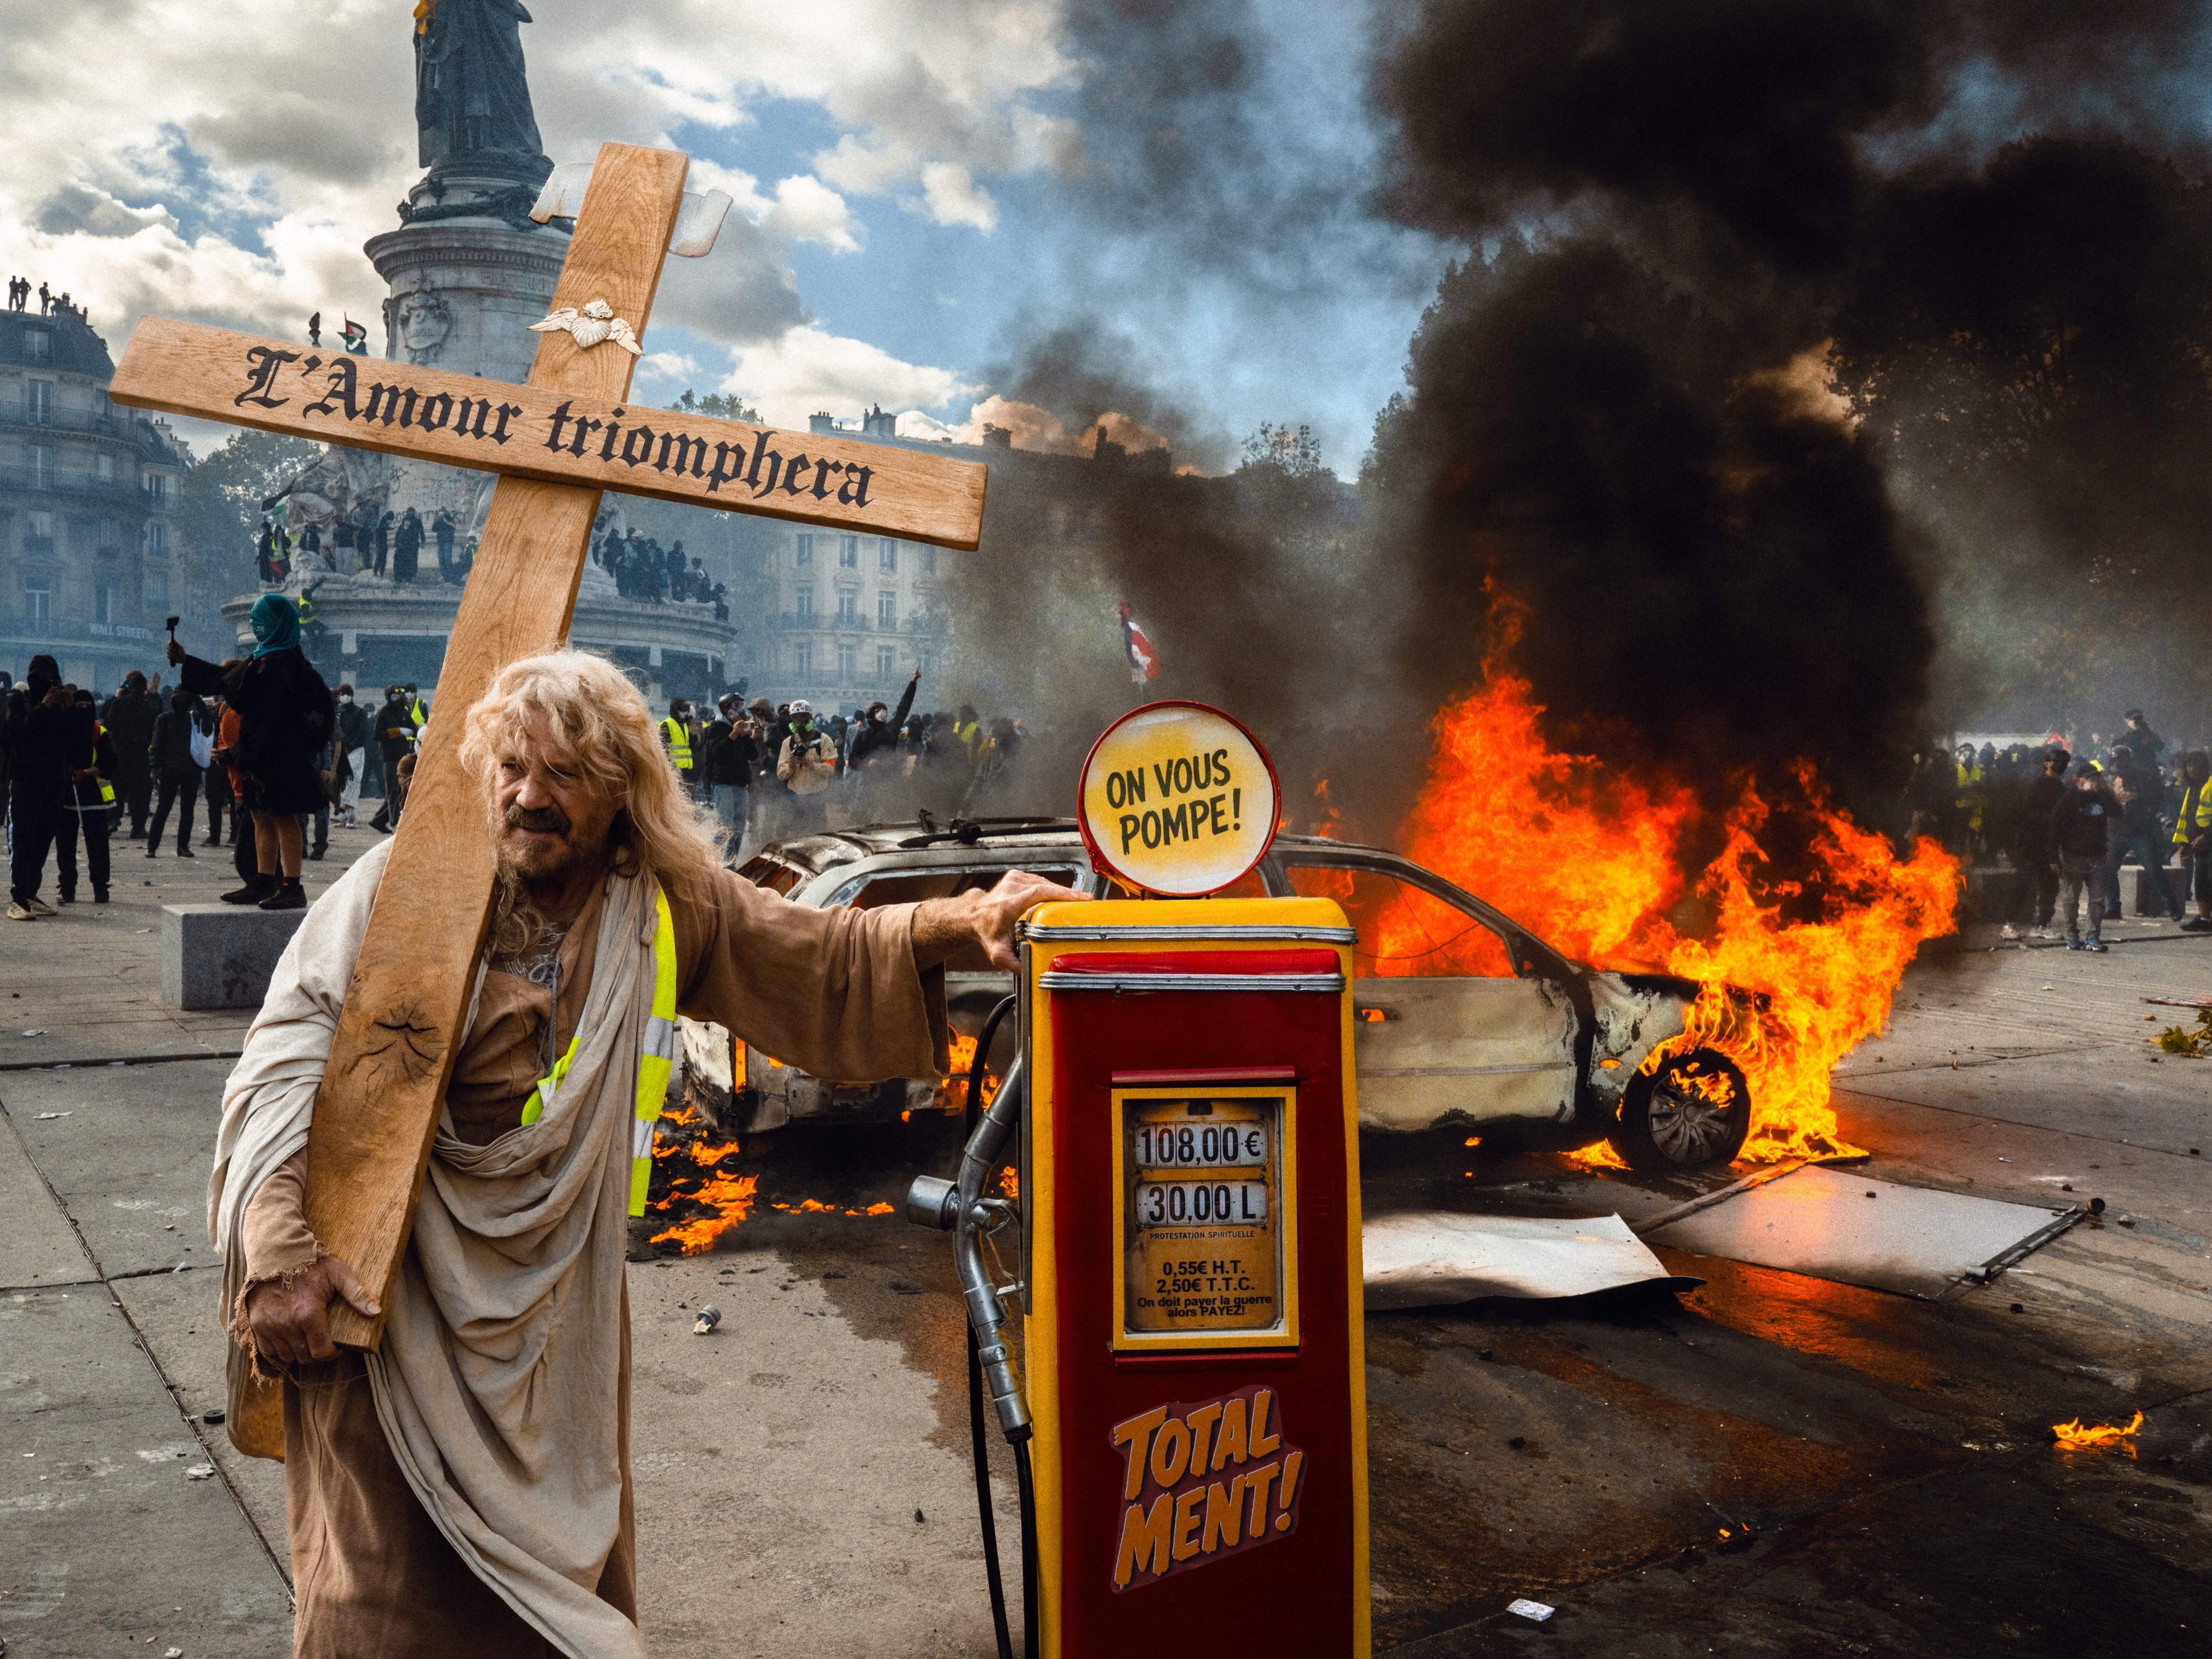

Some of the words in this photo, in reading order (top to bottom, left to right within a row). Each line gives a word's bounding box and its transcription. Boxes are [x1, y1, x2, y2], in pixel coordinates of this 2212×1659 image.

[234, 346, 523, 446] L'Amour
[542, 400, 876, 509] triomphera
[90, 623, 114, 636] WALL
[1107, 767, 1146, 809] ON
[1154, 748, 1231, 798] VOUS
[1119, 788, 1241, 855] POMPE!
[1149, 1185, 1231, 1224] 30,00
[1242, 1185, 1256, 1219] L
[1150, 1232, 1205, 1240] PROTESTATION
[1163, 1261, 1208, 1278] 0,55€
[1212, 1260, 1246, 1274] H.T.
[1156, 1278, 1202, 1296] 2,50€
[1206, 1277, 1256, 1292] T.T.C.
[1137, 1297, 1155, 1307] On
[1158, 1297, 1181, 1307] doit
[1184, 1297, 1217, 1309] payer
[1220, 1296, 1230, 1305] la
[1233, 1296, 1272, 1308] guerre
[1167, 1307, 1197, 1317] alors
[1201, 1305, 1246, 1316] PAYEZ!
[1114, 1389, 1280, 1501] TOTAL
[1114, 1451, 1303, 1589] MENT!
